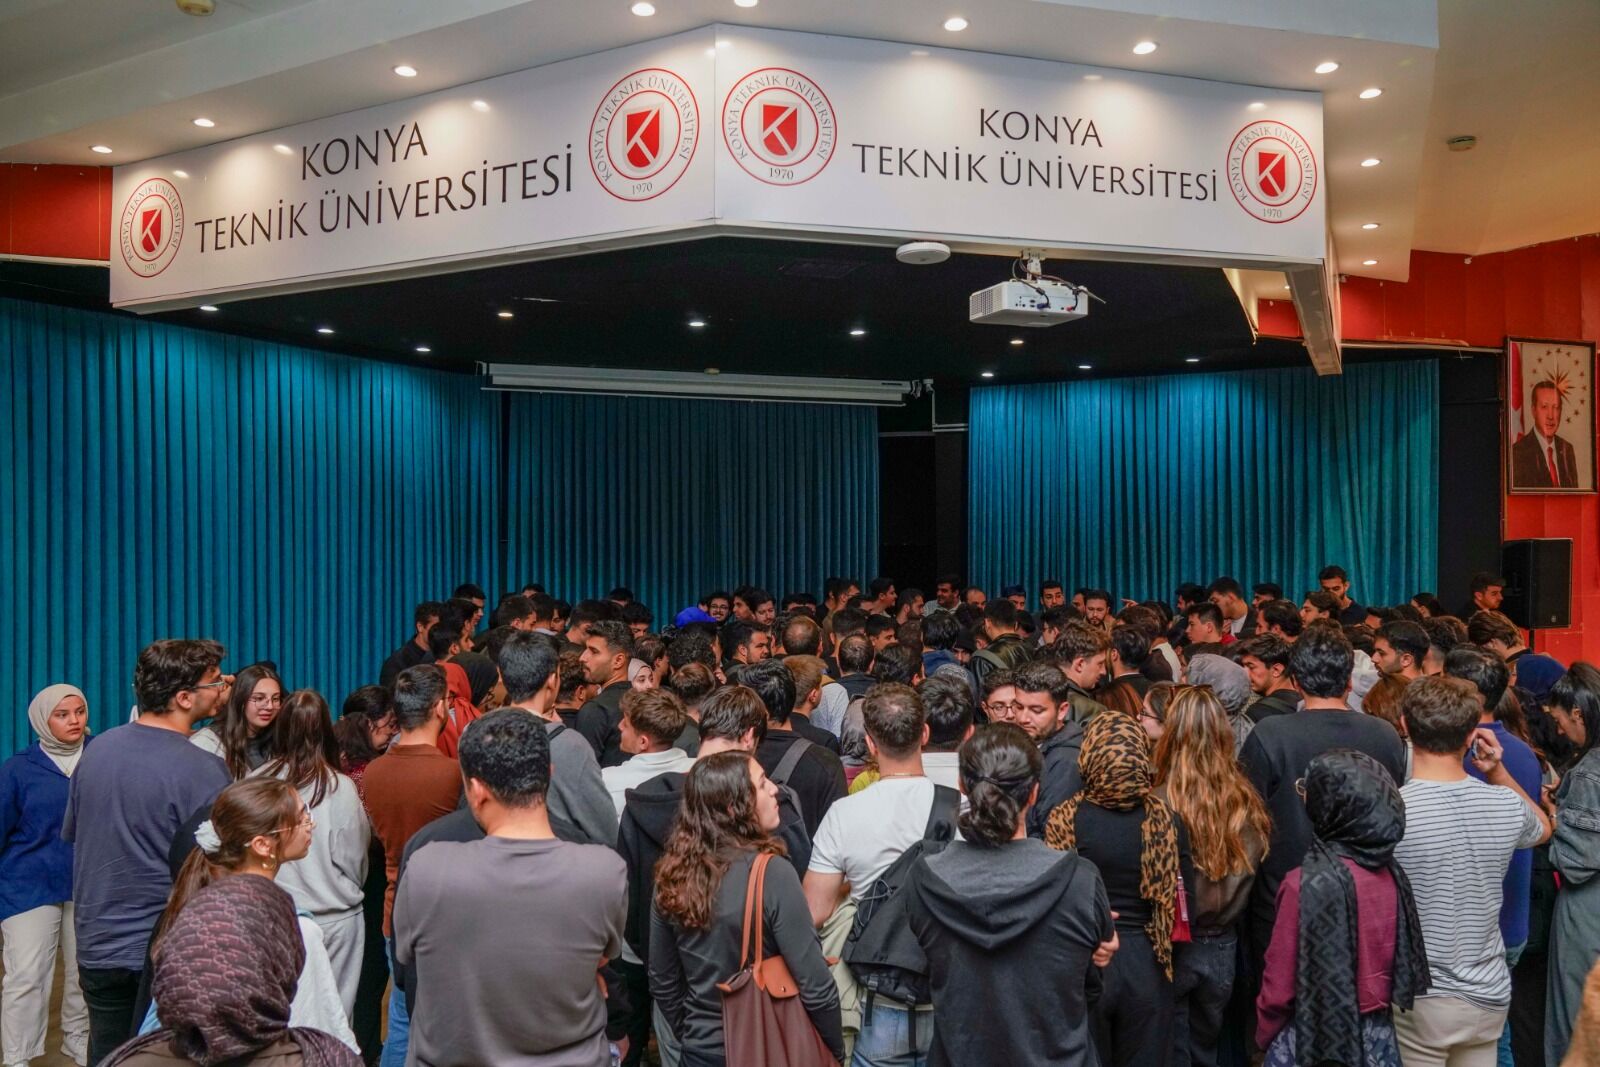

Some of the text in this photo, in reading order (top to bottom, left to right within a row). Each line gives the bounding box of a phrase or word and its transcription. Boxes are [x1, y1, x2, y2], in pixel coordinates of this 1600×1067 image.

[980, 107, 1103, 148] KONYA
[301, 121, 428, 180] KONYA
[632, 182, 653, 195] 1970
[769, 167, 794, 180] 1970
[852, 143, 1218, 201] TEKNİK ÜNİVERSİTESİ
[194, 143, 573, 253] TEKNİK ÜNİVERSİTESİ
[1263, 208, 1283, 218] 1970
